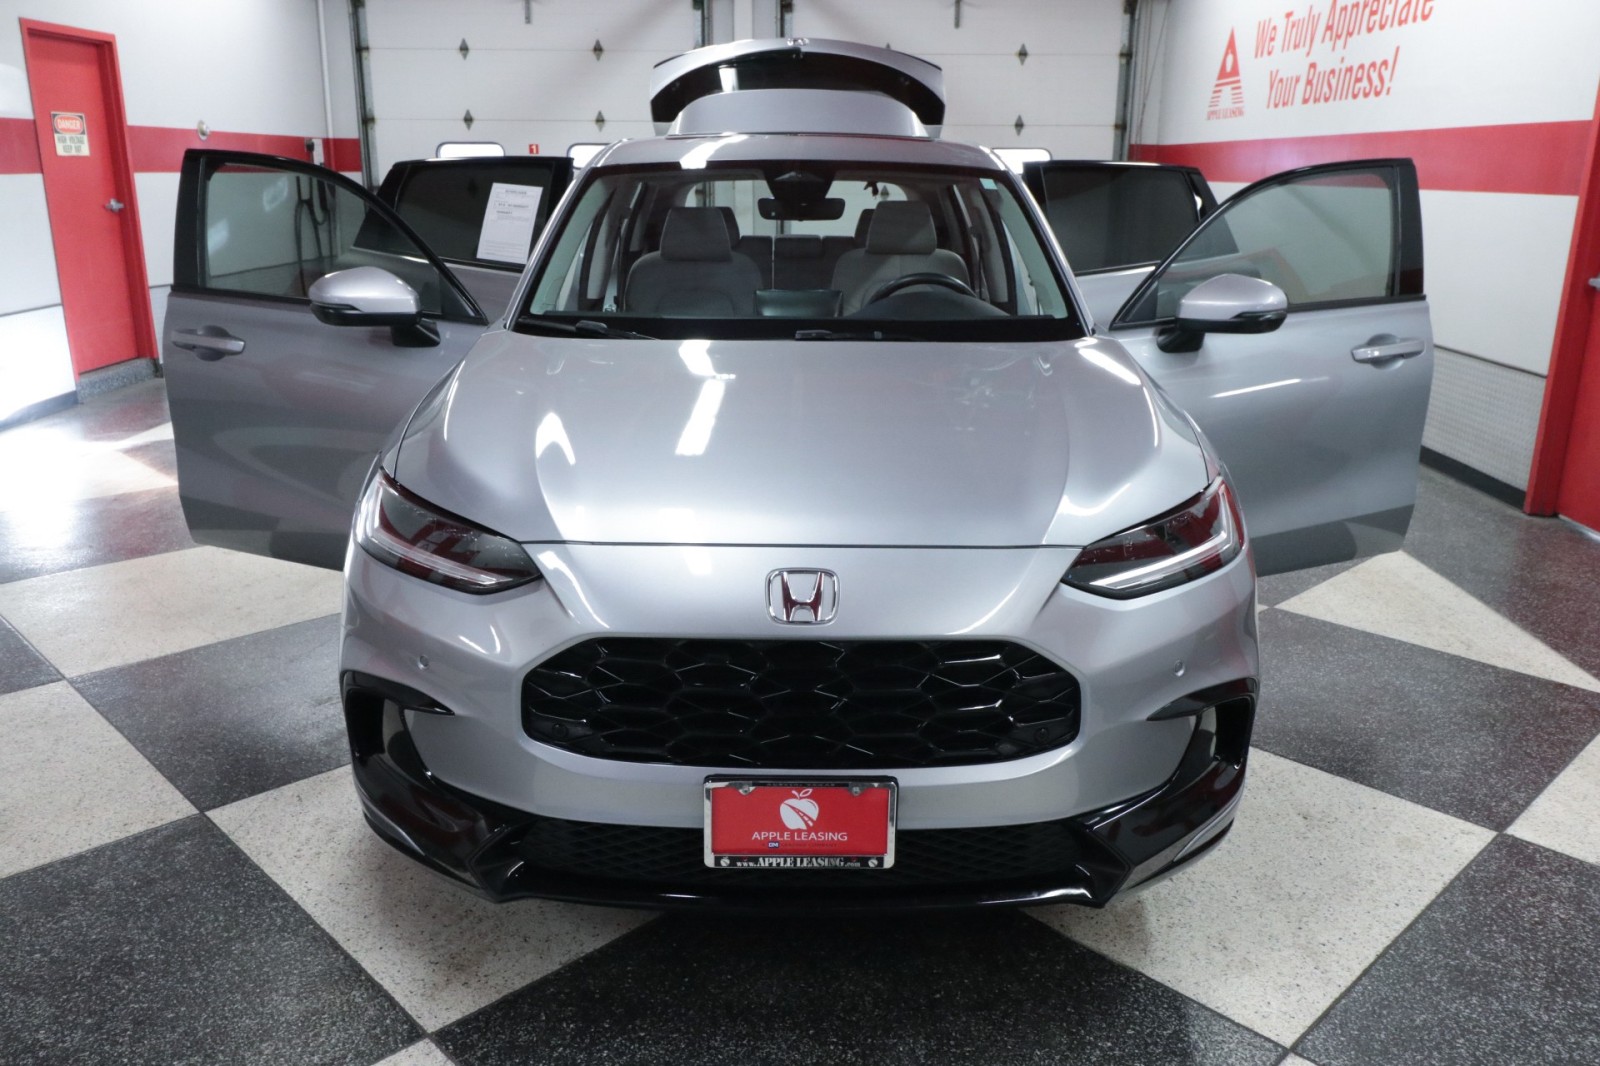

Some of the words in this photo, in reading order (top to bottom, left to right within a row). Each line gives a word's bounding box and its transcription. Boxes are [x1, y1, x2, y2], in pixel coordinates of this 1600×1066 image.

[1254, 18, 1278, 59] We
[1281, 5, 1322, 57] Truly
[1266, 69, 1301, 109] Your
[1302, 46, 1400, 105] Business!
[57, 118, 81, 130] DANGER
[752, 831, 791, 841] APPLE
[794, 831, 848, 841] LEASING
